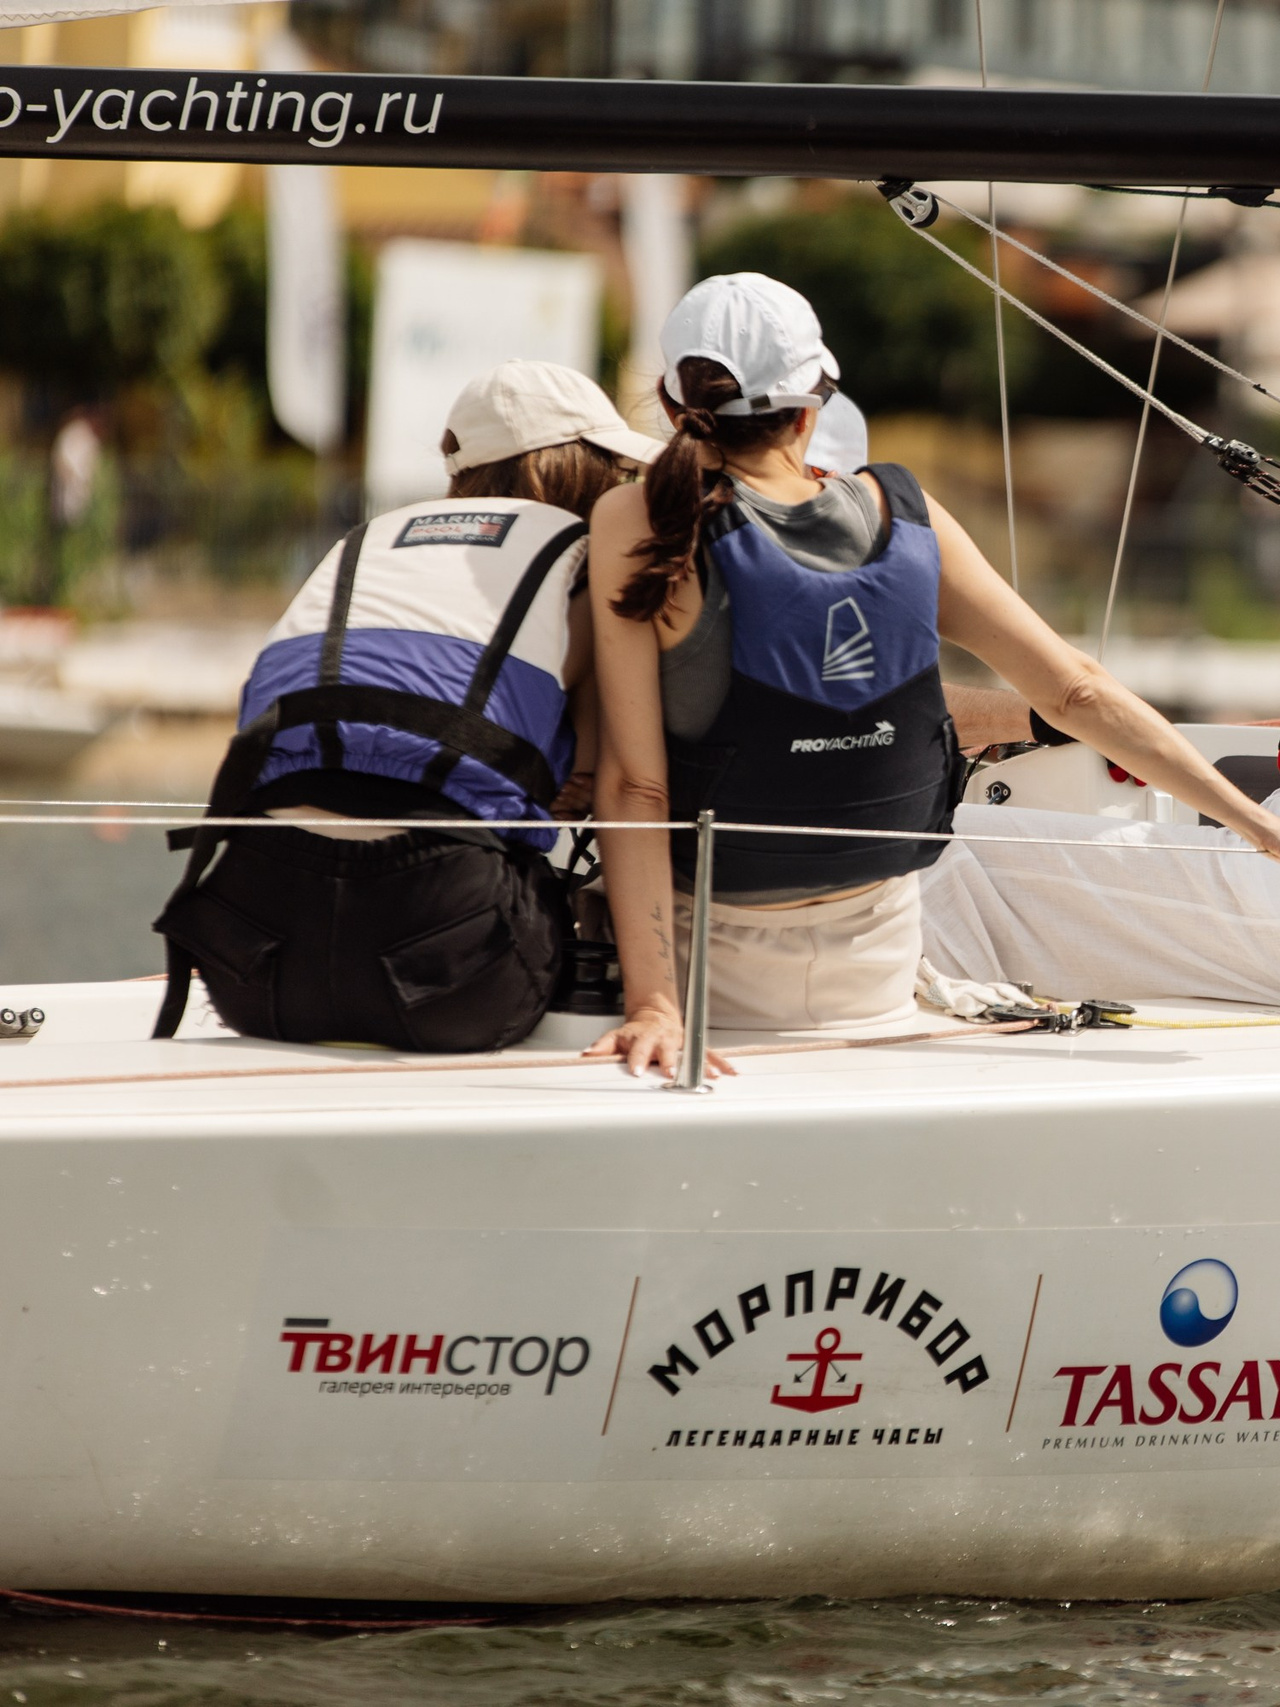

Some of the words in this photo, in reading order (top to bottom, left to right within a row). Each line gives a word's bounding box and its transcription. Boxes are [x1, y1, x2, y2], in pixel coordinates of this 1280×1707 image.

[790, 731, 894, 753] PROYACHTING
[646, 1266, 990, 1397] МОРПРИБОР
[318, 1380, 396, 1398] галерея
[398, 1381, 513, 1399] интерьеров
[665, 1429, 861, 1449] ЛЕГЕНДАРНЫЕ
[871, 1427, 944, 1445] ЧАСЫ
[1041, 1436, 1126, 1451] PREMIUM
[1134, 1432, 1226, 1448] DRINKING
